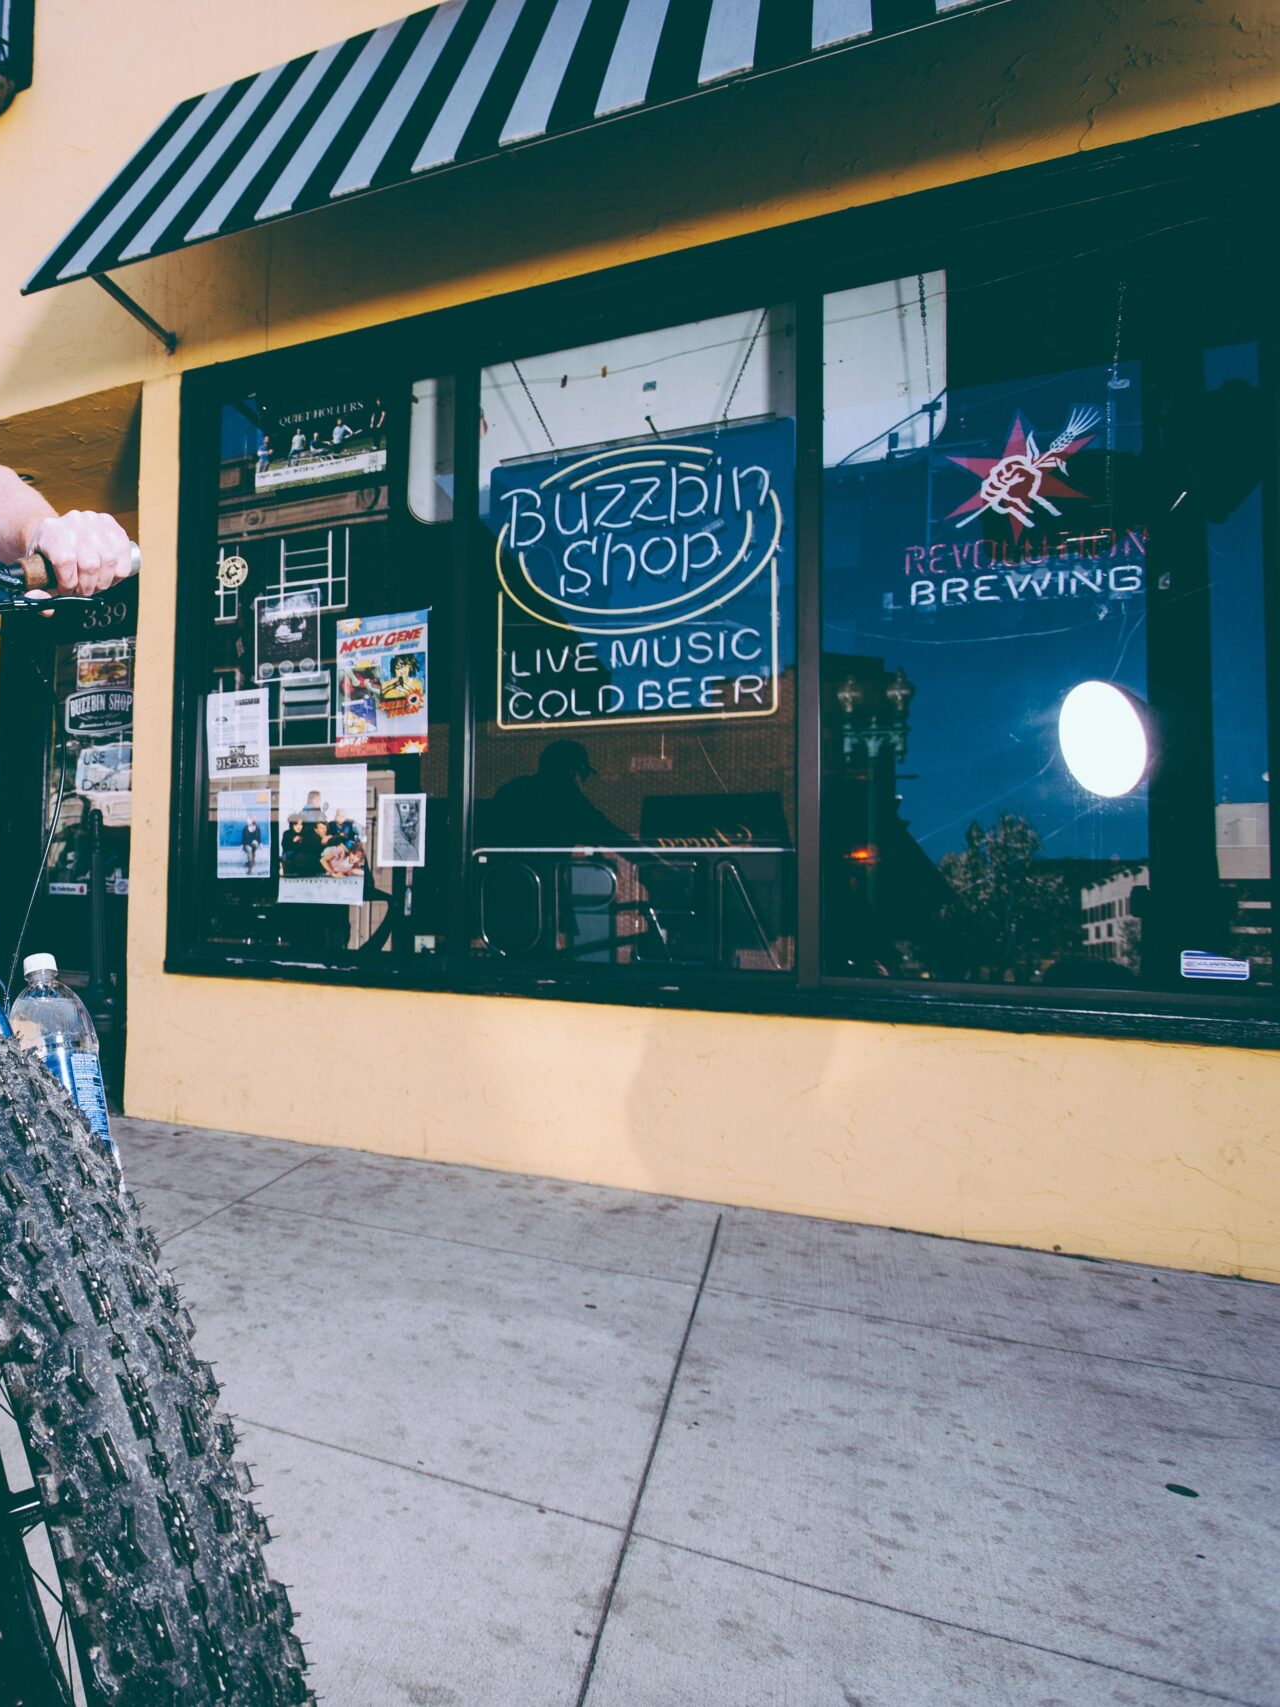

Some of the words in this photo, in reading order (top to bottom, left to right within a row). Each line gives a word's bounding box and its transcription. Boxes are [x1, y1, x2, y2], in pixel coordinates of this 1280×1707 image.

[500, 456, 771, 549] Buzzbin
[904, 527, 1150, 577] REVOLUTION
[910, 564, 1144, 607] BREWING
[82, 602, 128, 629] 339
[339, 633, 385, 655] MOLLY
[384, 626, 424, 648] GENE
[511, 641, 599, 677] LIVE
[610, 627, 763, 669] MUSIC
[70, 694, 106, 718] BUZZBIN
[108, 692, 133, 712] SHOP
[508, 684, 625, 721] COLD
[637, 674, 765, 711] BEER
[83, 750, 107, 766] USE
